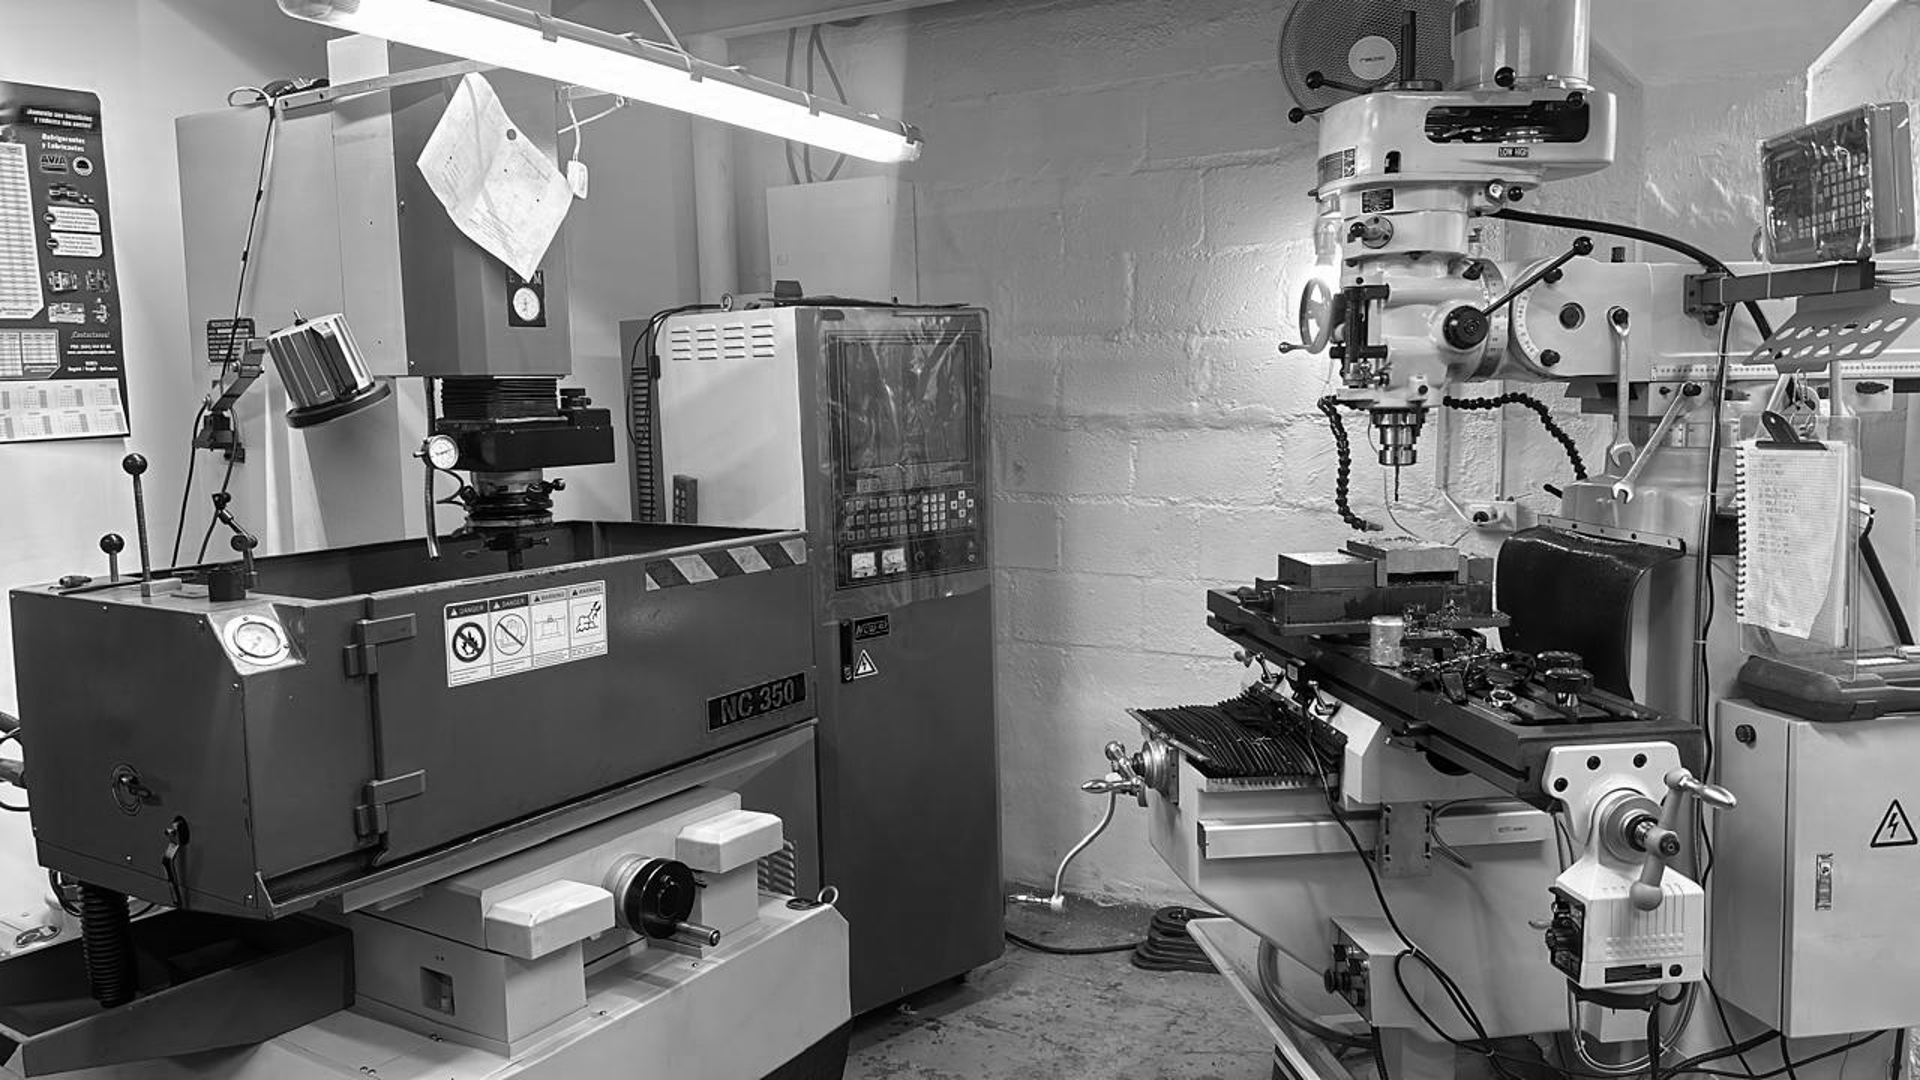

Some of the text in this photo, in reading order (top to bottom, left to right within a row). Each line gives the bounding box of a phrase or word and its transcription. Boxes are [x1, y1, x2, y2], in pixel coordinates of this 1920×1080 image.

[41, 133, 85, 144] Refrigerantes
[47, 142, 85, 152] Lubricantes
[1499, 148, 1512, 157] LOW
[41, 155, 66, 164] AVIA
[578, 586, 601, 595] WARNING
[541, 592, 565, 601] WARNING
[501, 598, 526, 607] DANGER
[458, 605, 484, 614] DANGER
[721, 679, 795, 723] NC 350
